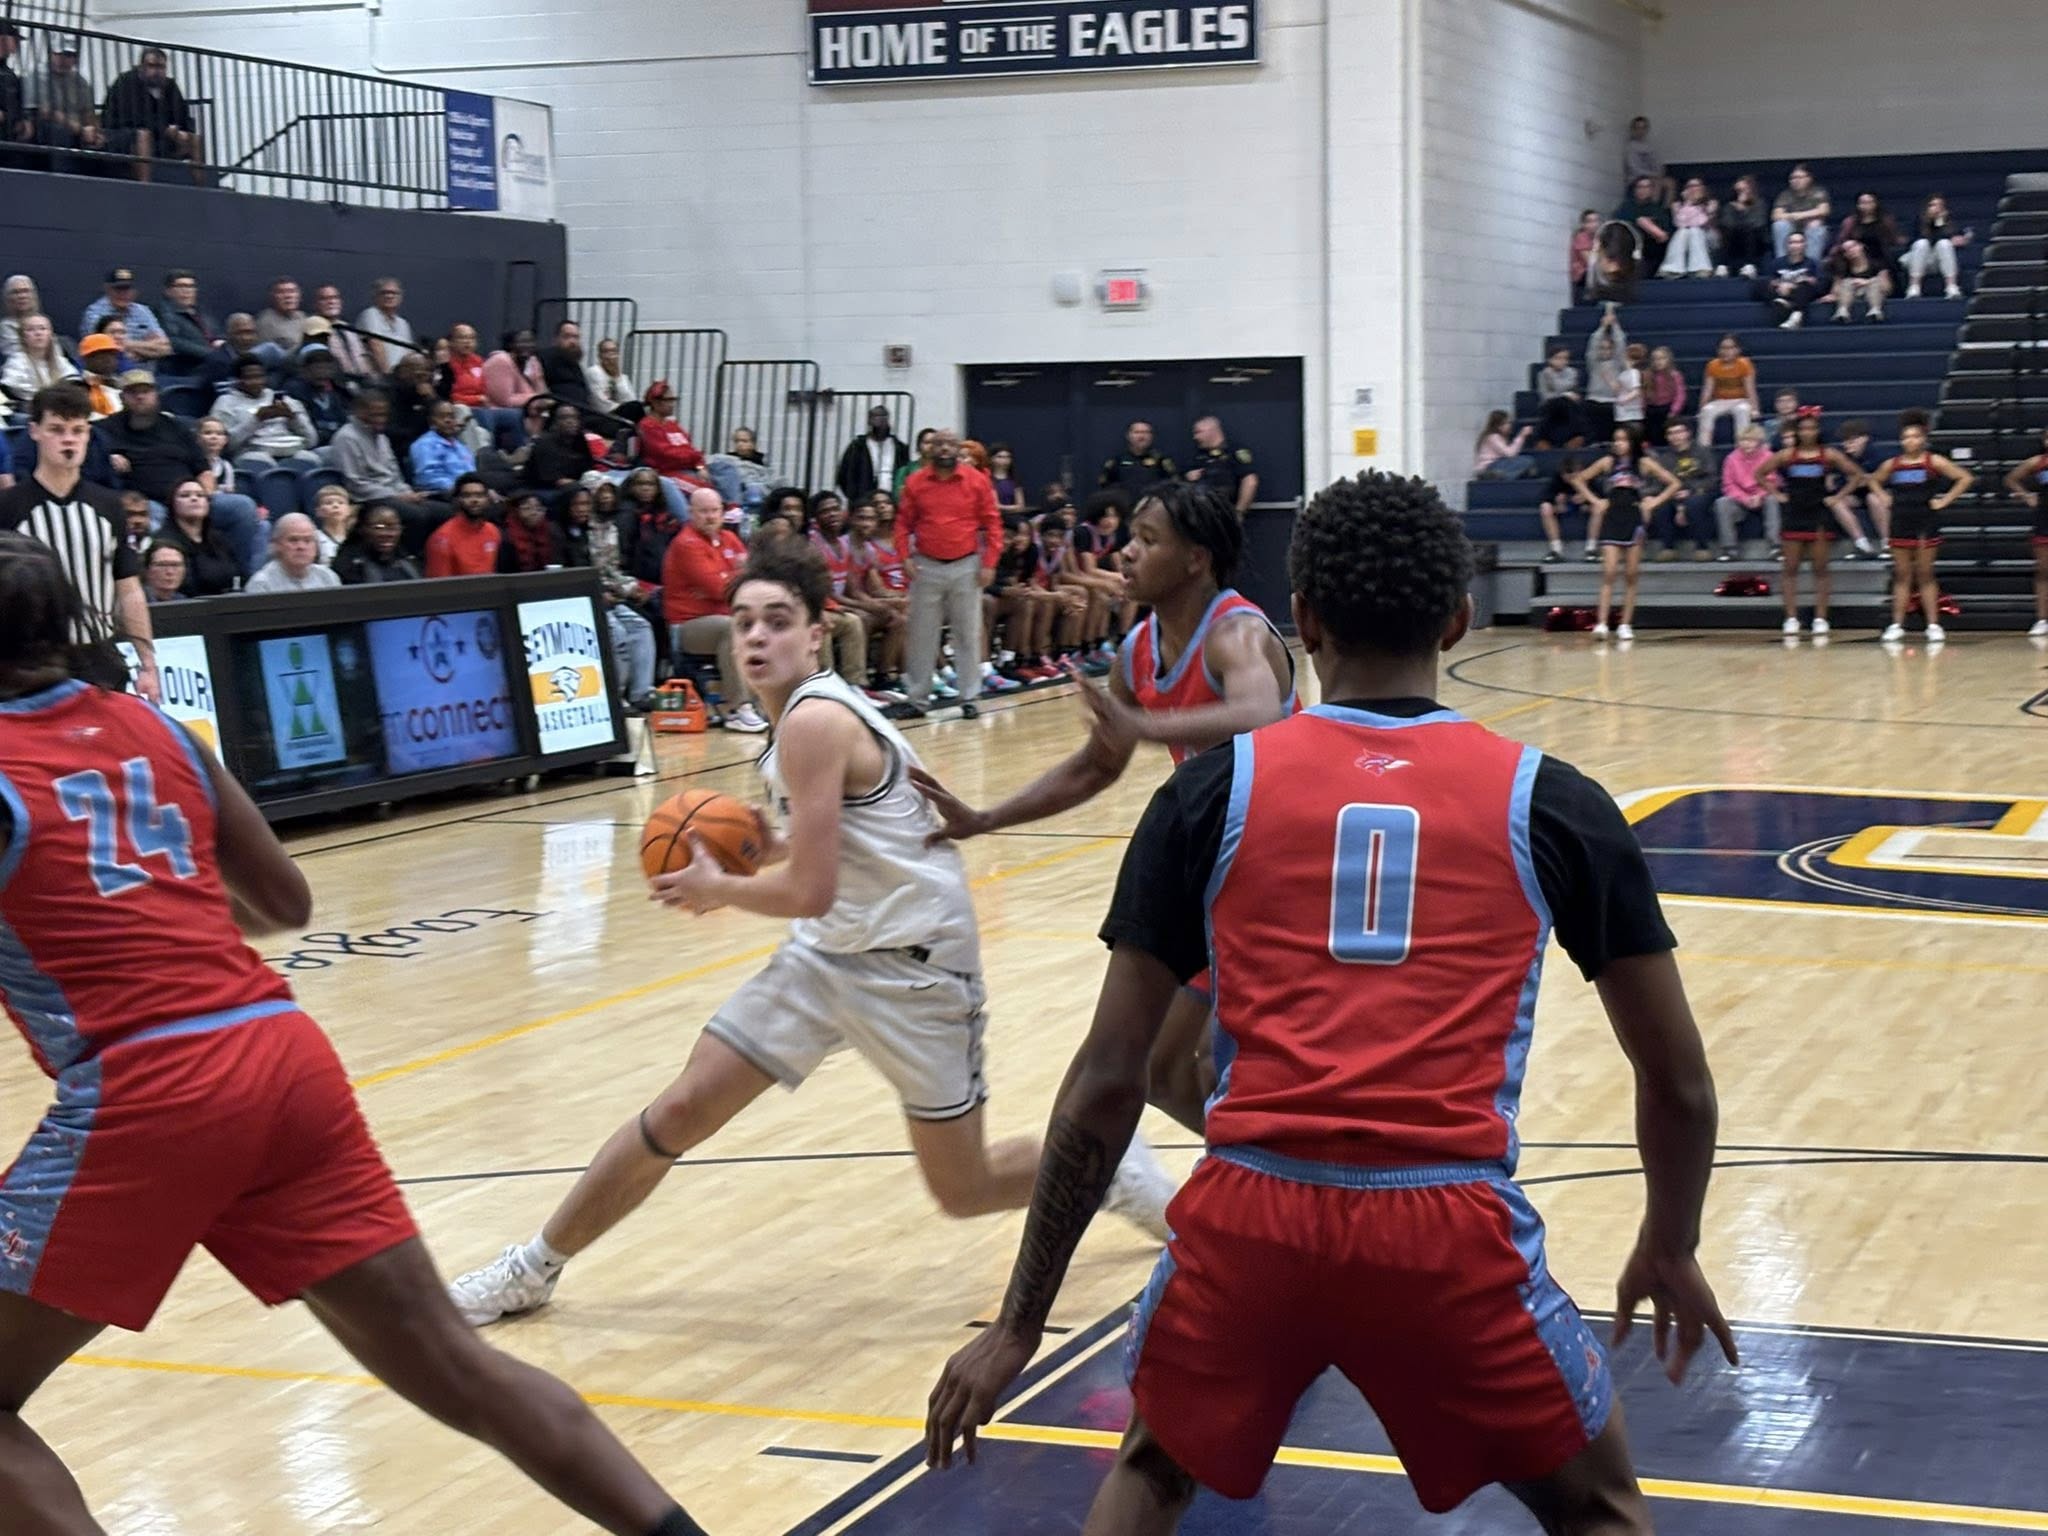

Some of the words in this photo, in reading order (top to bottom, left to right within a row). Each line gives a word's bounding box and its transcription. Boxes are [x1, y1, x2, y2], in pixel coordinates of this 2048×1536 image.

[818, 22, 948, 70] HOME
[959, 27, 994, 54] OF
[1002, 24, 1056, 53] THE
[1068, 5, 1249, 58] EAGLES
[52, 756, 199, 897] 24
[1328, 803, 1421, 966] 0
